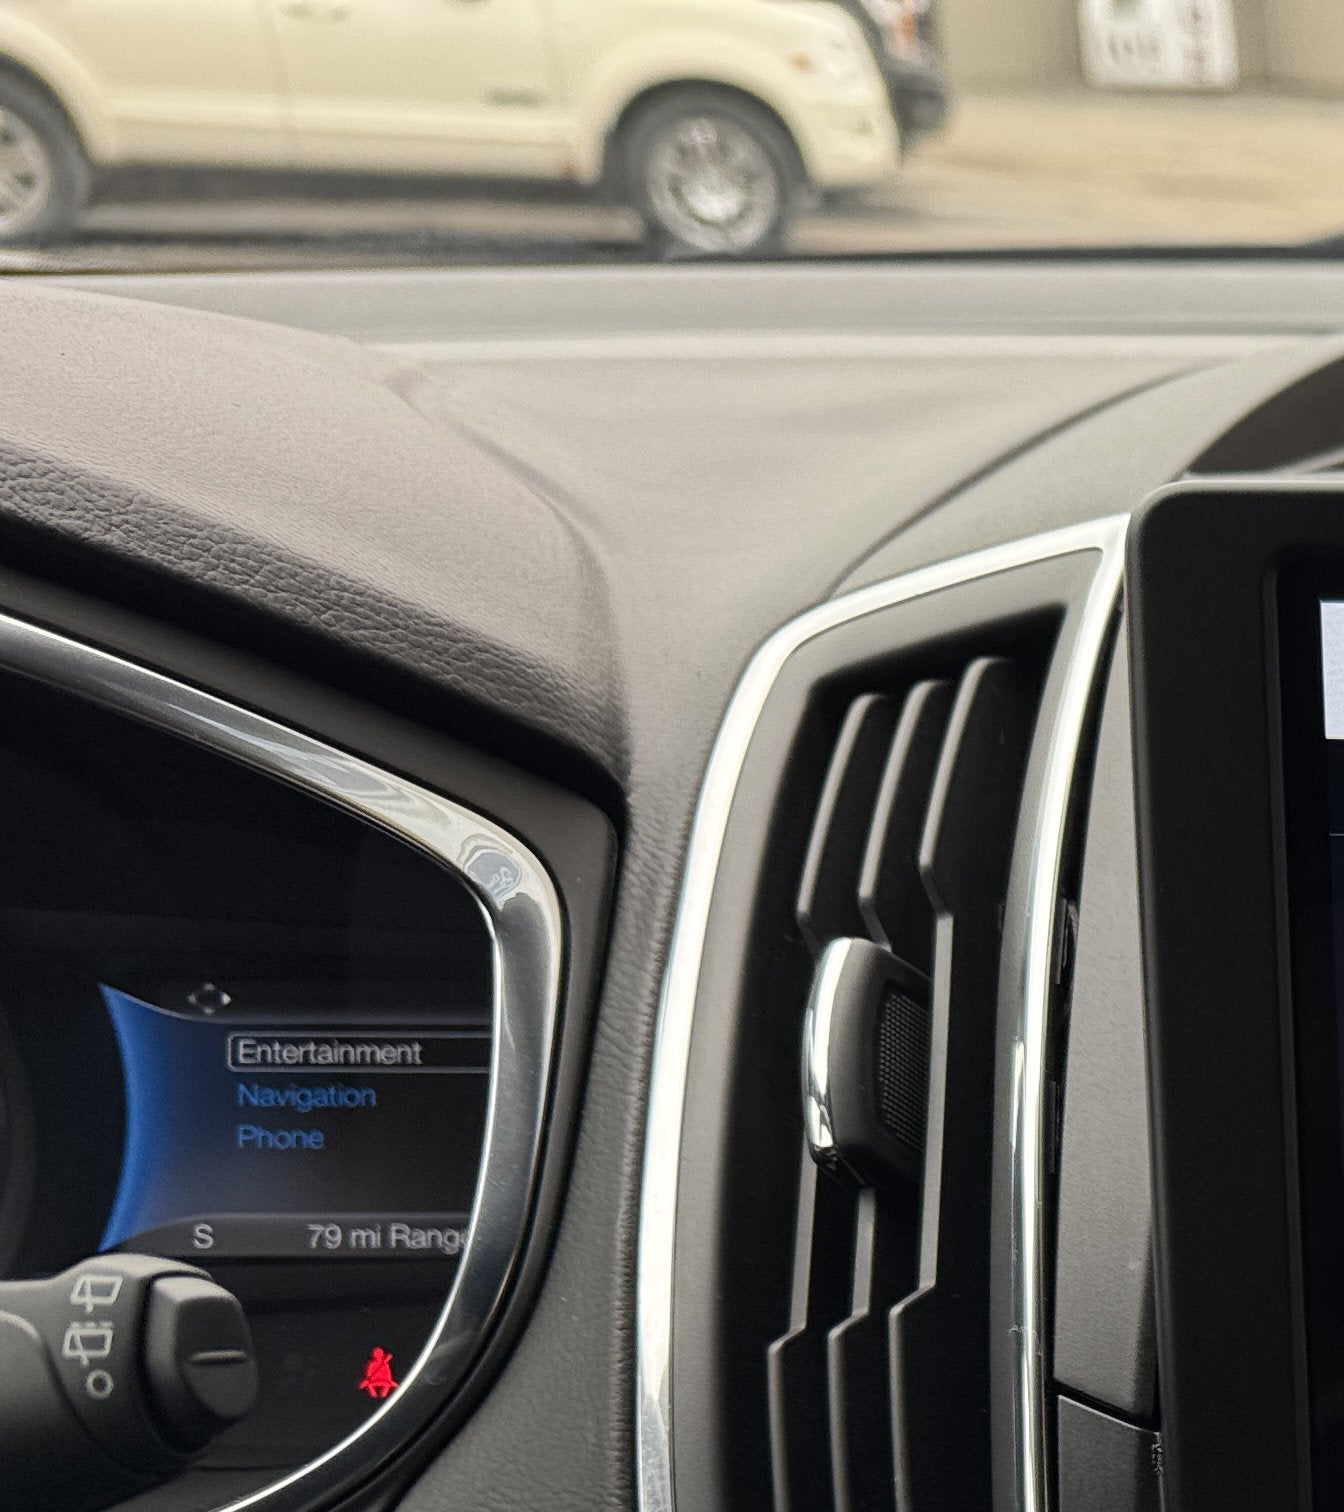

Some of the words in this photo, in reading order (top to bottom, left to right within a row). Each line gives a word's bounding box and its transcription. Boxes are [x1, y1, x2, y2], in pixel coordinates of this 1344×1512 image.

[237, 1040, 423, 1066] Entertainment
[236, 1083, 377, 1112] Navigation
[236, 1123, 325, 1151] Phone
[193, 1224, 214, 1249] S
[307, 1223, 342, 1249] 79
[350, 1223, 381, 1249] mi
